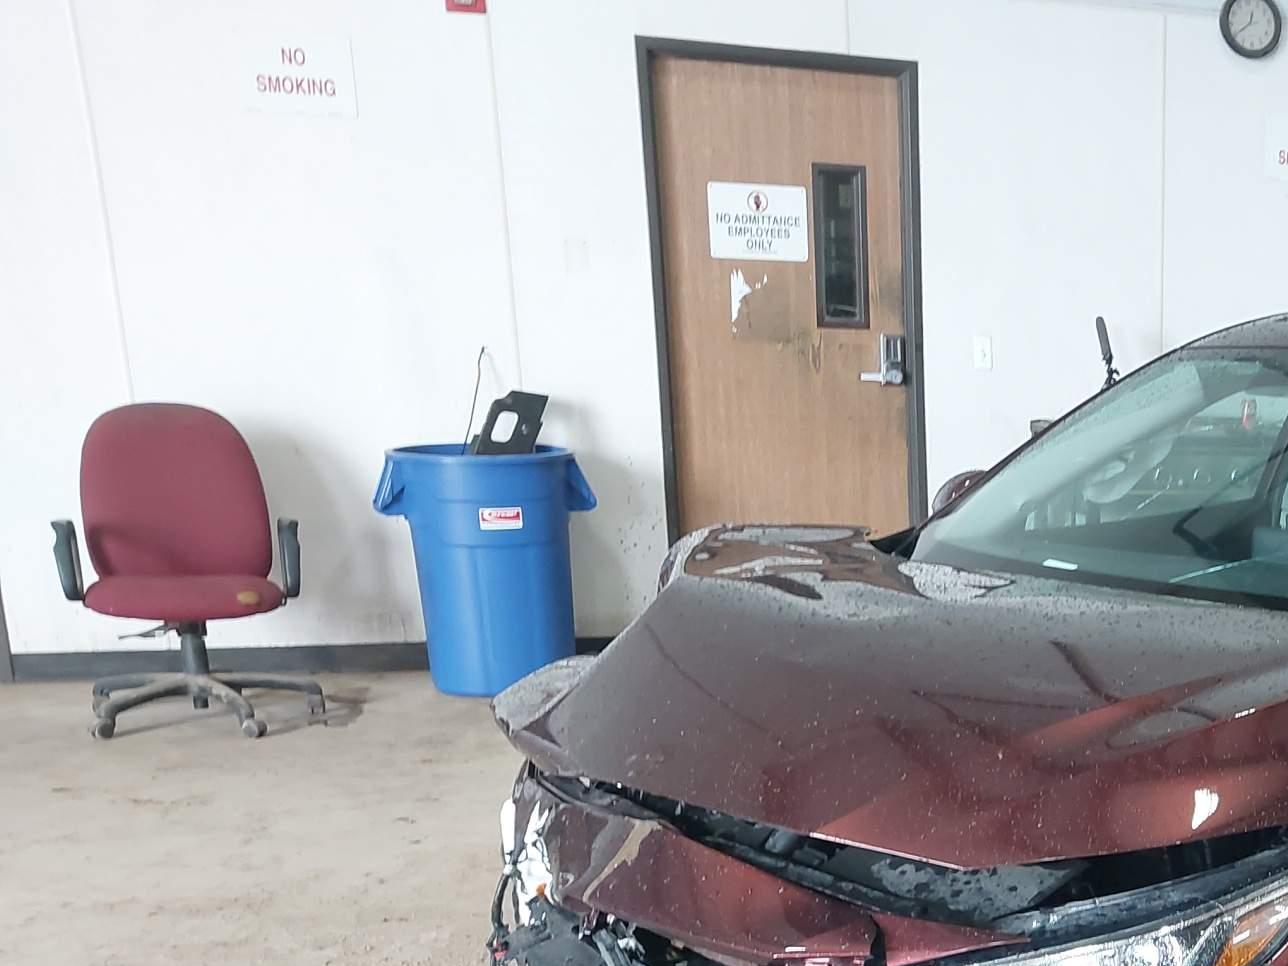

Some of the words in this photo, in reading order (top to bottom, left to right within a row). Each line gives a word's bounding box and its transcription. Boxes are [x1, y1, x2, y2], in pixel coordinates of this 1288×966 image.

[281, 47, 306, 66] NO
[256, 74, 336, 97] SMOKING
[715, 211, 731, 225] NO
[733, 212, 801, 228] ADMITTANCE
[727, 225, 791, 240] EMPLOYEES
[746, 239, 773, 251] ONLY
